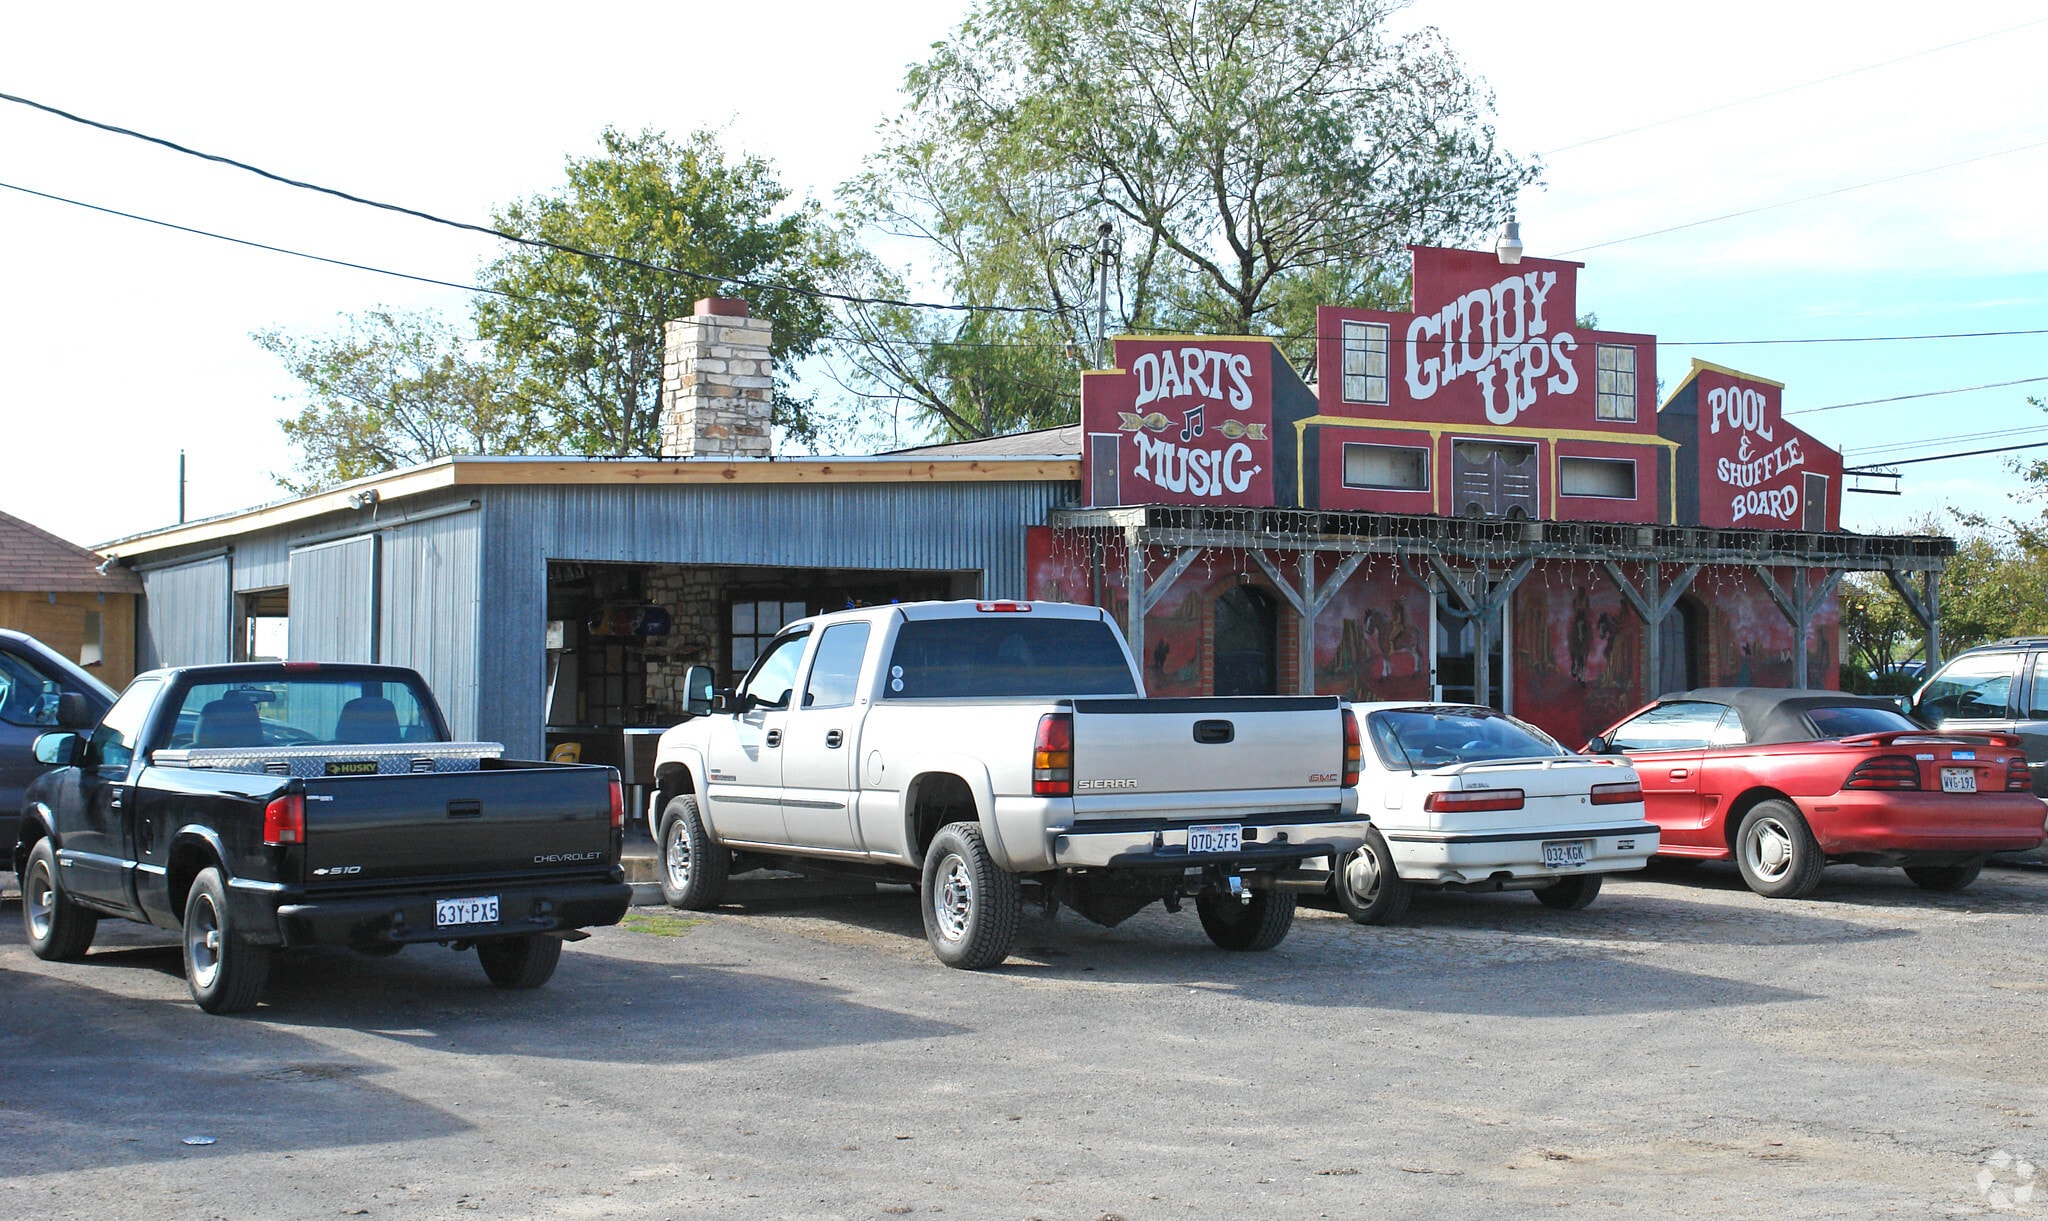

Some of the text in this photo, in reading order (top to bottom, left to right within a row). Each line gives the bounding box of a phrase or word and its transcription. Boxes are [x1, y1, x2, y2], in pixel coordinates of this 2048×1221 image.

[1405, 271, 1557, 400] GIDDY
[1133, 348, 1253, 413] DARTS
[1476, 332, 1579, 425] UPS
[1708, 386, 1773, 442] POOL
[1717, 437, 1805, 488] SHUFFLE
[1738, 435, 1756, 462] &
[1732, 485, 1798, 523] BOARD
[341, 763, 377, 774] HUSKY
[1077, 779, 1138, 790] SIERRA
[1308, 773, 1338, 783] GMC
[329, 866, 362, 875] S10
[533, 851, 602, 864] CHEVROLET
